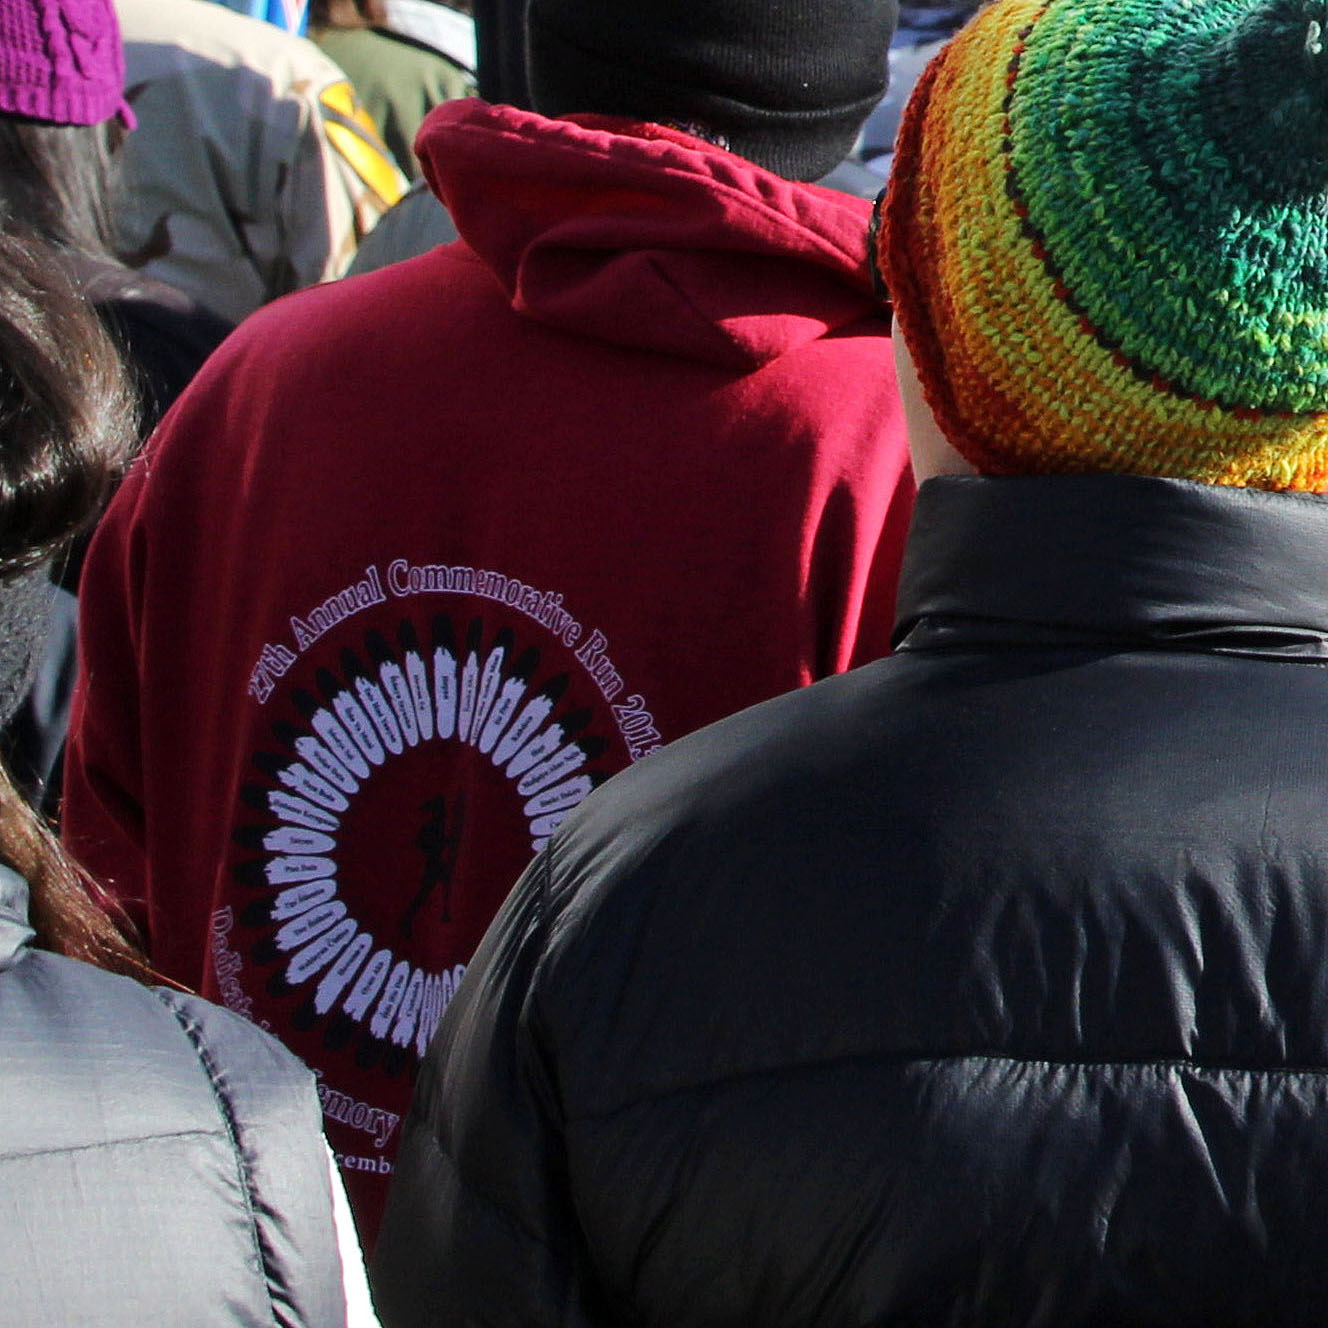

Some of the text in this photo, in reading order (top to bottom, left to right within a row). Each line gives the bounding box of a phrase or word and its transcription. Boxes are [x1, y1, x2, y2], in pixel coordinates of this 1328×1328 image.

[249, 643, 297, 704] 27th
[290, 565, 387, 652] Annual
[388, 558, 582, 647] Commemorative
[575, 628, 624, 702] Run
[317, 1078, 400, 1148] emory
